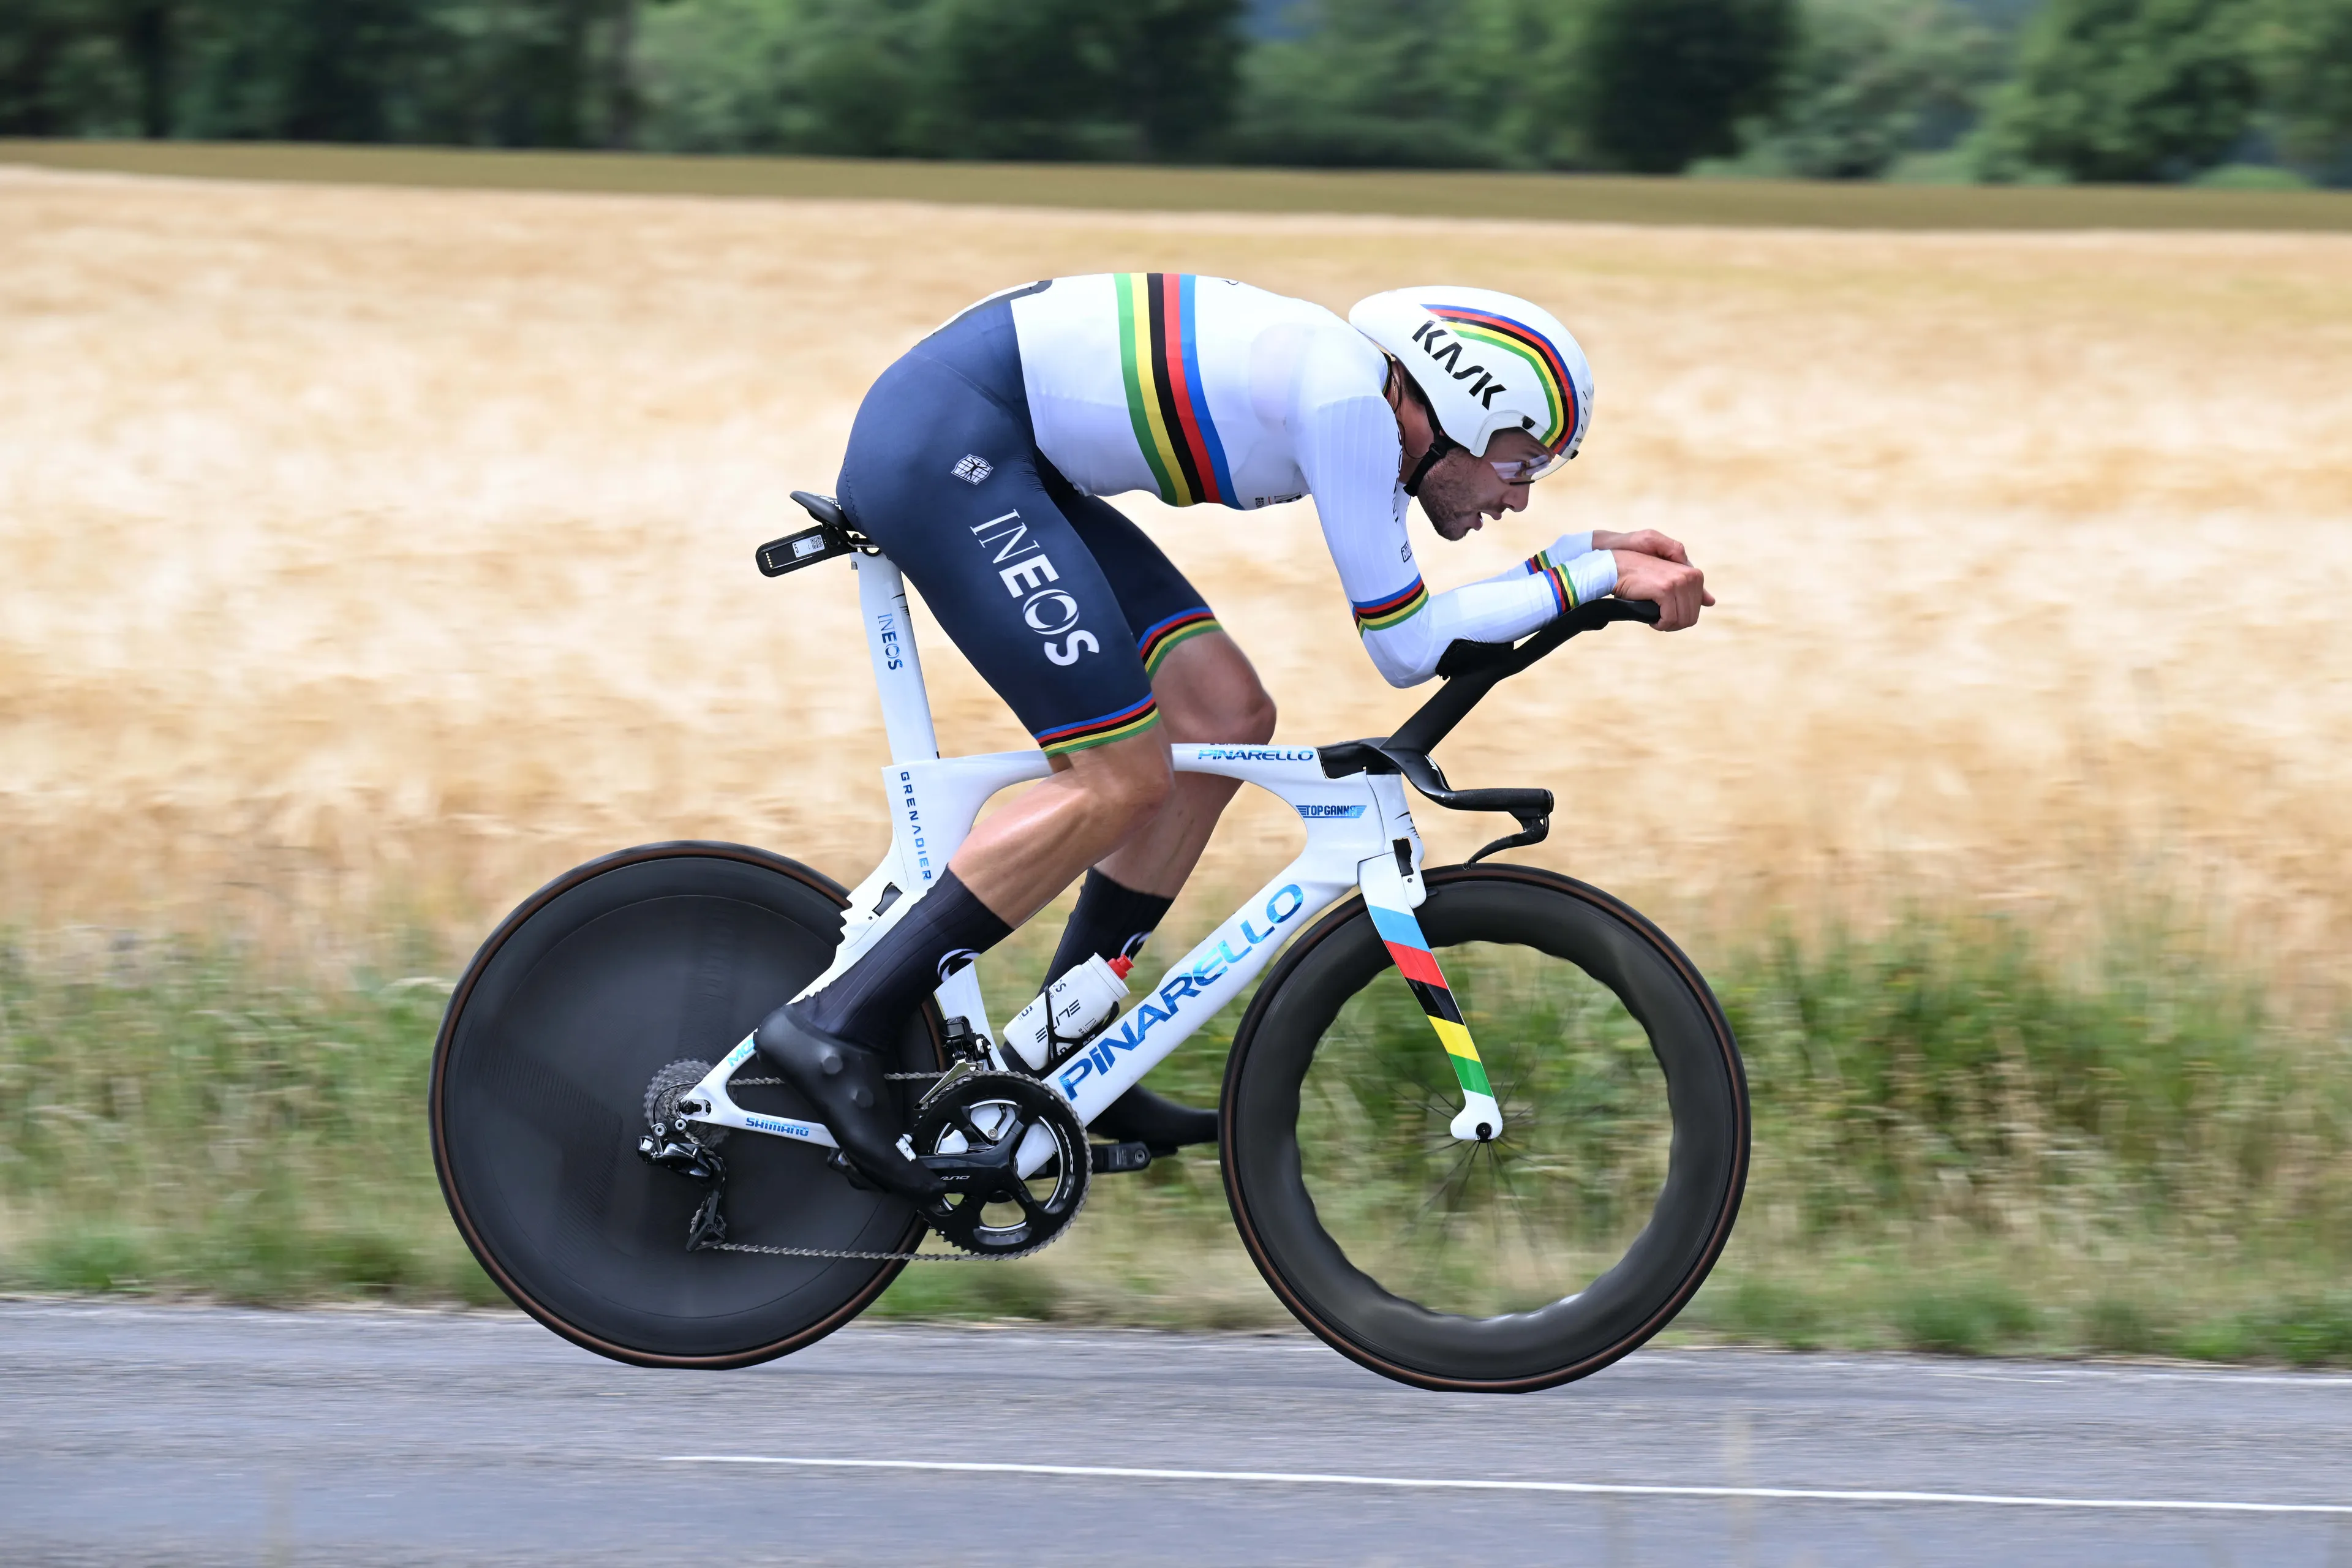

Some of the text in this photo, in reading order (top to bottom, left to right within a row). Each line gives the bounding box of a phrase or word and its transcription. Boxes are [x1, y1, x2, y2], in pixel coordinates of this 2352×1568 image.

[1411, 319, 1507, 410] KASK
[970, 508, 1099, 666] INEOS
[877, 612, 903, 671] INEOS
[1197, 749, 1314, 761] PINARELLO
[900, 771, 932, 881] GRENADIER
[1058, 884, 1303, 1101] PINARELLO
[727, 1039, 755, 1067] MO
[745, 1117, 809, 1137] SHIMANO
